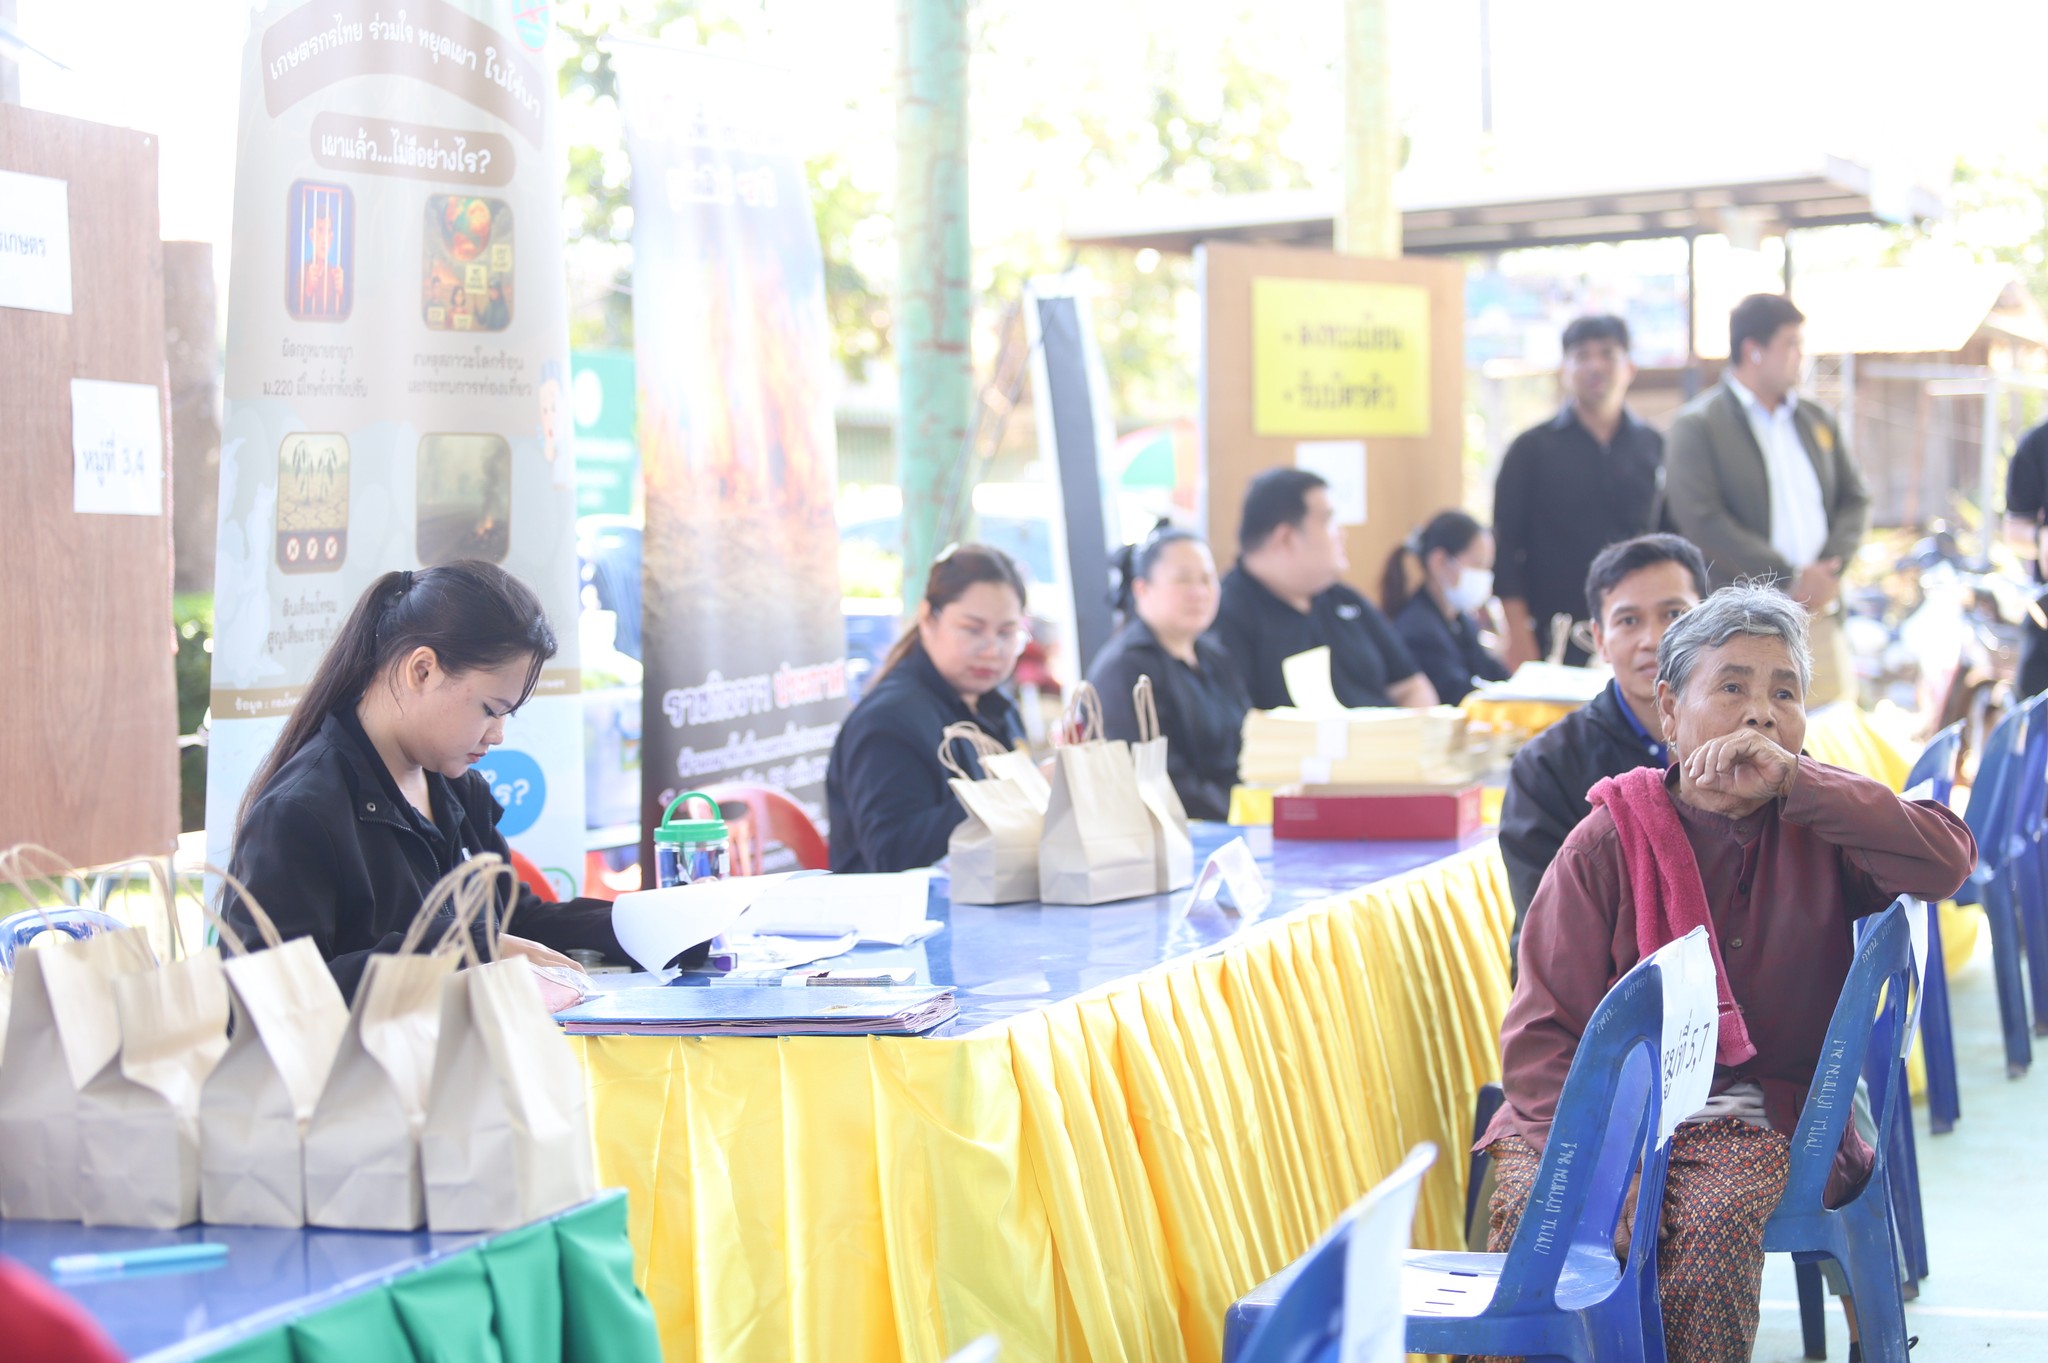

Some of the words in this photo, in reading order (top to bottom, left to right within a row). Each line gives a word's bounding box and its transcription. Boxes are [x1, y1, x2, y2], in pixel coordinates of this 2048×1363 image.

[270, 14, 364, 80] เกษตรกรไทย
[369, 9, 414, 44] ร่วมใจ
[418, 27, 478, 71] หยุดเผา
[484, 45, 541, 117] ในไร่นา
[1533, 1220, 1559, 1256] กทบ.
